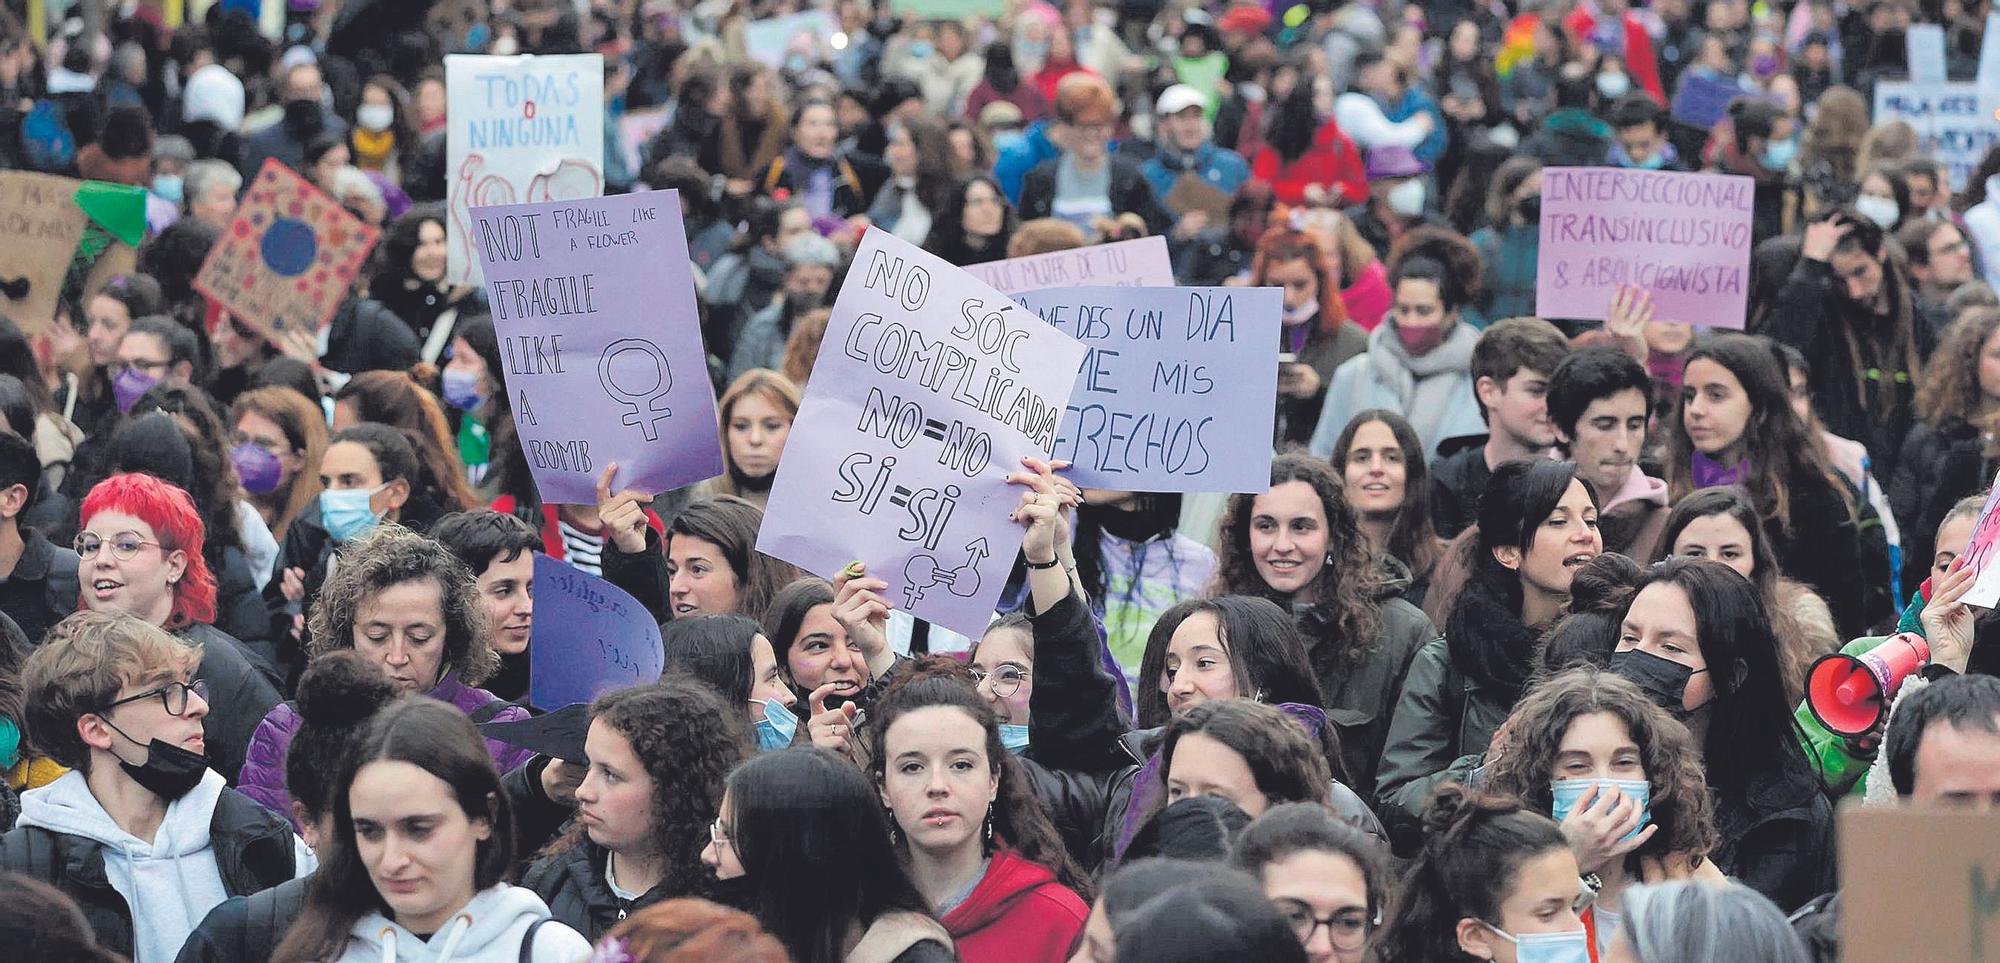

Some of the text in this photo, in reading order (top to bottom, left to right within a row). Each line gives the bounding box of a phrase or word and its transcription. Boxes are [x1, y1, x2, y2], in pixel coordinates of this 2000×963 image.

[475, 71, 580, 108] TODAS
[524, 100, 536, 119] O
[469, 114, 579, 149] NINGUNA
[552, 207, 657, 229] FRAGILE LIKE
[480, 213, 541, 263] NOT
[569, 230, 639, 252] A FLOWER
[1021, 256, 1071, 286] MUJER
[1076, 251, 1095, 280] DE
[1103, 246, 1126, 274] TU
[493, 274, 598, 320] FRAGILE
[865, 249, 1030, 374] NO SÓC
[1076, 305, 1113, 340] DES
[1126, 308, 1163, 341] UN
[506, 335, 566, 375] LIKE
[520, 389, 538, 426] A
[528, 439, 593, 474] BOMB
